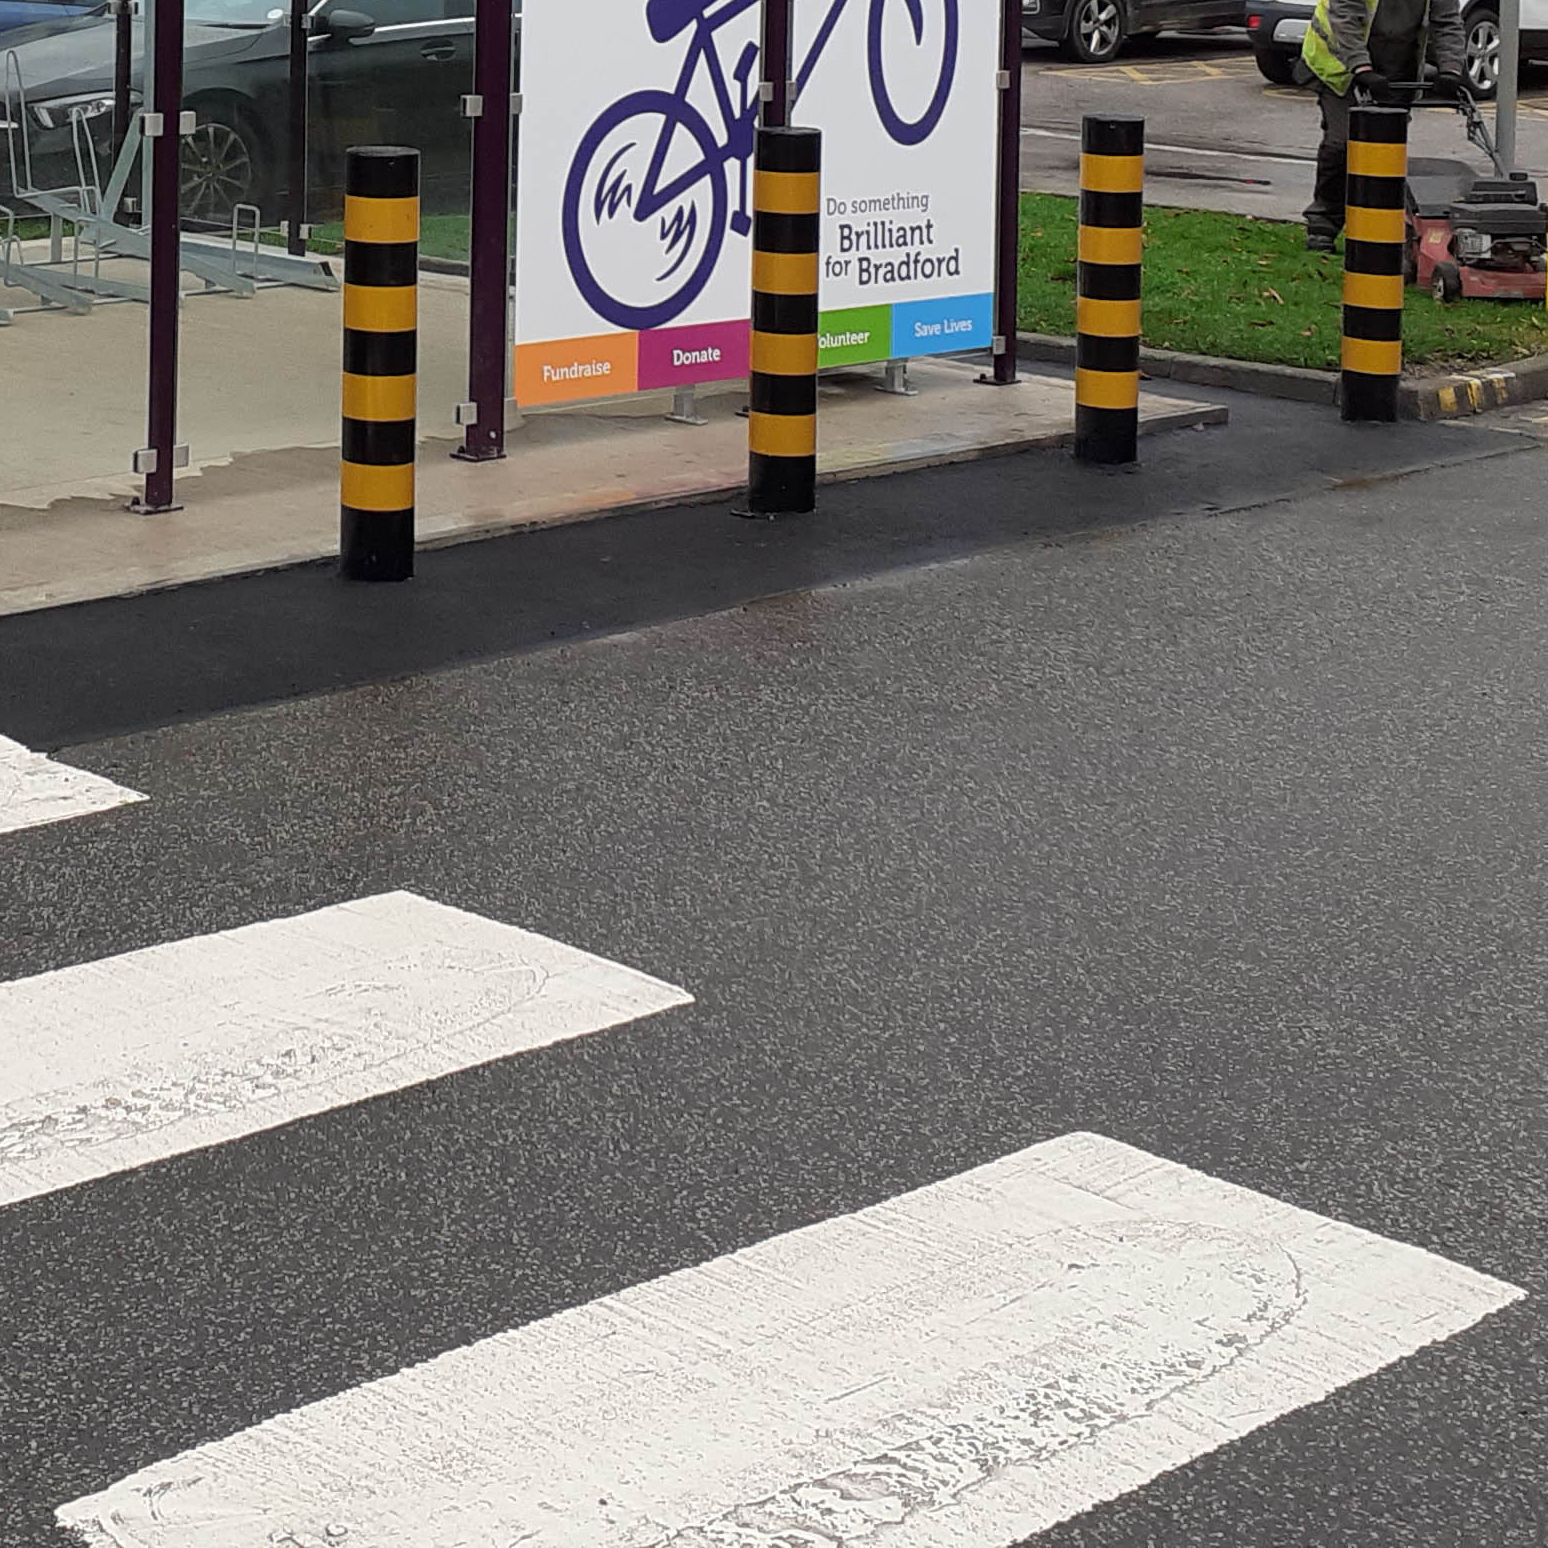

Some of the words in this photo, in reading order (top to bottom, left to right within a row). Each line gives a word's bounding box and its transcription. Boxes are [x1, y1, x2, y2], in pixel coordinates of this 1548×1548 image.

[826, 197, 846, 216] Do
[851, 192, 929, 214] something
[838, 219, 933, 253] Brilliant
[825, 255, 851, 278] for
[857, 247, 960, 286] Bradford
[818, 331, 870, 349] olunteer
[914, 321, 941, 338] Save
[944, 319, 973, 332] Lives
[673, 347, 721, 366] Donate
[542, 359, 611, 382] Fundraise
